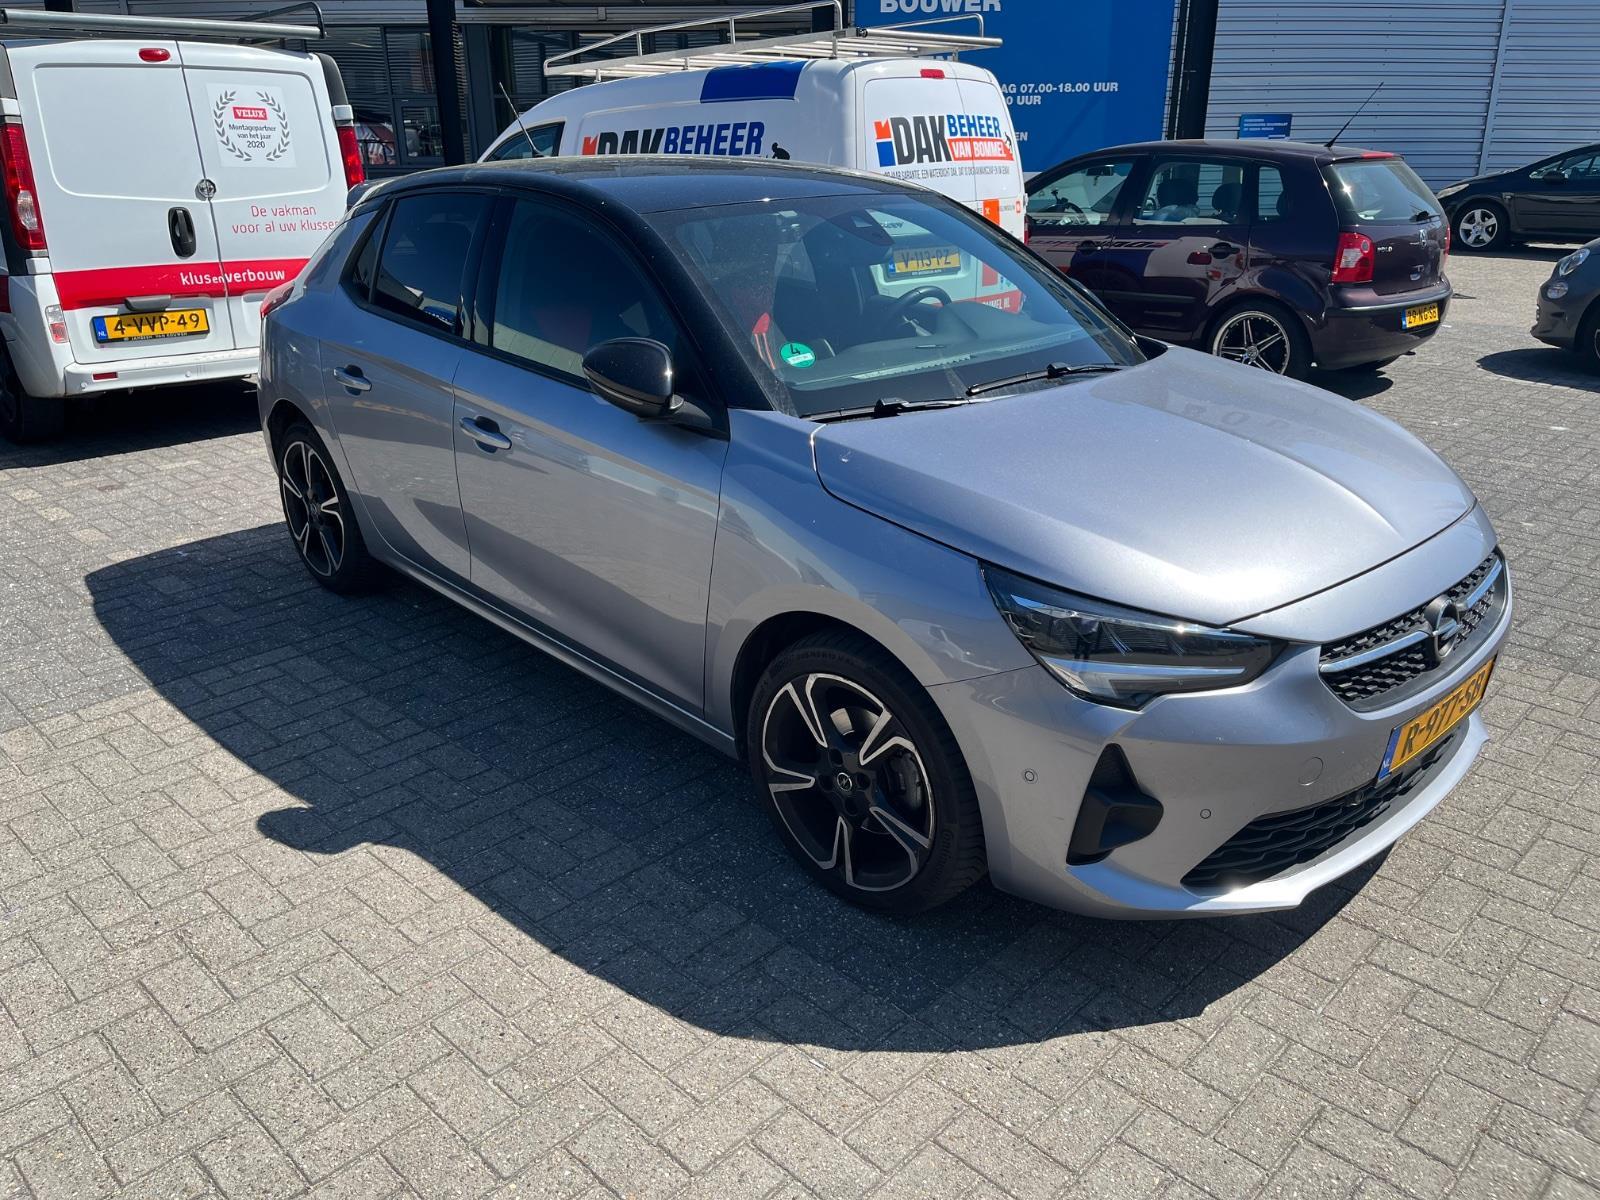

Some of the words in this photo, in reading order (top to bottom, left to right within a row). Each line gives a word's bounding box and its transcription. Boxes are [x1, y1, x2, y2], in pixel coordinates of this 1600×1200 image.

[880, 0, 1001, 13] BOUWER
[1001, 84, 1016, 94] AG
[1020, 83, 1090, 93] 07.00-18.00
[1093, 82, 1119, 92] UUR
[1006, 96, 1013, 105] 0
[1017, 95, 1042, 105] UUR
[236, 109, 265, 118] VELUX
[228, 124, 276, 132] Montagepartner
[664, 121, 765, 155] BEHEER
[890, 116, 952, 165] DAK
[946, 114, 1002, 138] BEHEER
[1015, 132, 1028, 141] EN
[952, 141, 971, 158] VAN
[973, 140, 1007, 158] BOMMEL
[251, 205, 267, 217] De
[271, 204, 317, 217] vakman
[232, 224, 259, 234] voor
[265, 221, 275, 232] al
[280, 222, 297, 232] uw
[902, 248, 951, 269] V-113-PZ
[114, 313, 200, 335] 4-VVP-49
[789, 343, 801, 354] 4
